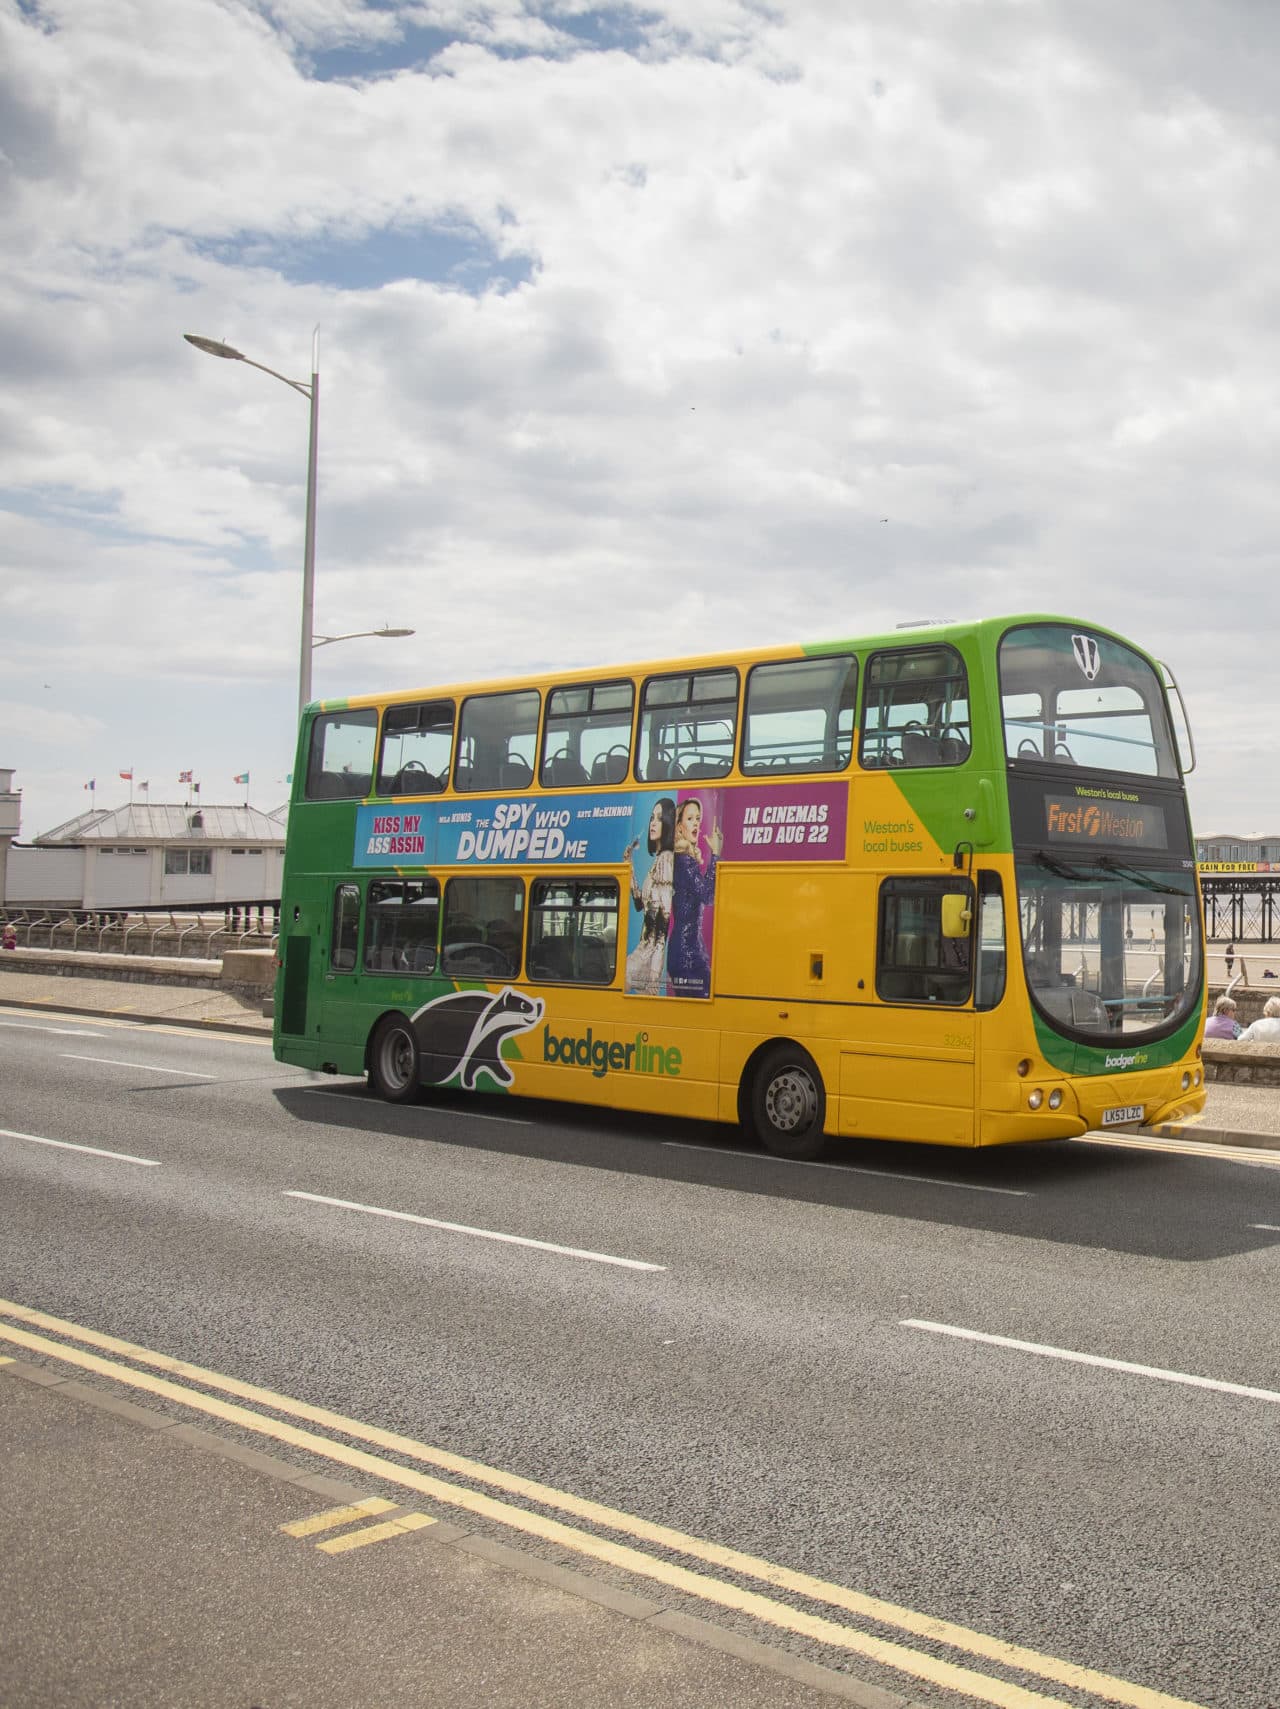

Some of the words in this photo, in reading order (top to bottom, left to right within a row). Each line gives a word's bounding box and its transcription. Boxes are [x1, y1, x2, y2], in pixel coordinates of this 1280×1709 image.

[1075, 786, 1106, 799] Weston's
[1107, 790, 1122, 800] local
[1122, 792, 1139, 803] buses
[476, 819, 490, 828] THE
[492, 803, 536, 830] SPY
[535, 811, 570, 828] WHO
[592, 806, 633, 818] McKINNON
[743, 808, 759, 824] IN
[762, 805, 828, 824] CINEMAS
[1048, 803, 1081, 834] First
[373, 817, 400, 834] KISS
[403, 816, 421, 833] MY
[864, 819, 915, 834] Weston's
[742, 828, 771, 844] WED
[775, 827, 805, 843] AUG
[807, 825, 829, 843] 22
[366, 836, 425, 854] ASSASSIN
[456, 828, 564, 860] DUMPED
[563, 840, 588, 858] ME
[863, 839, 888, 852] local
[890, 838, 922, 852] buses
[1238, 863, 1255, 871] FREE
[543, 1024, 683, 1078] badgerline
[1105, 1051, 1148, 1069] badgerline
[1105, 1109, 1125, 1122] LK53
[1126, 1107, 1141, 1119] LZC
